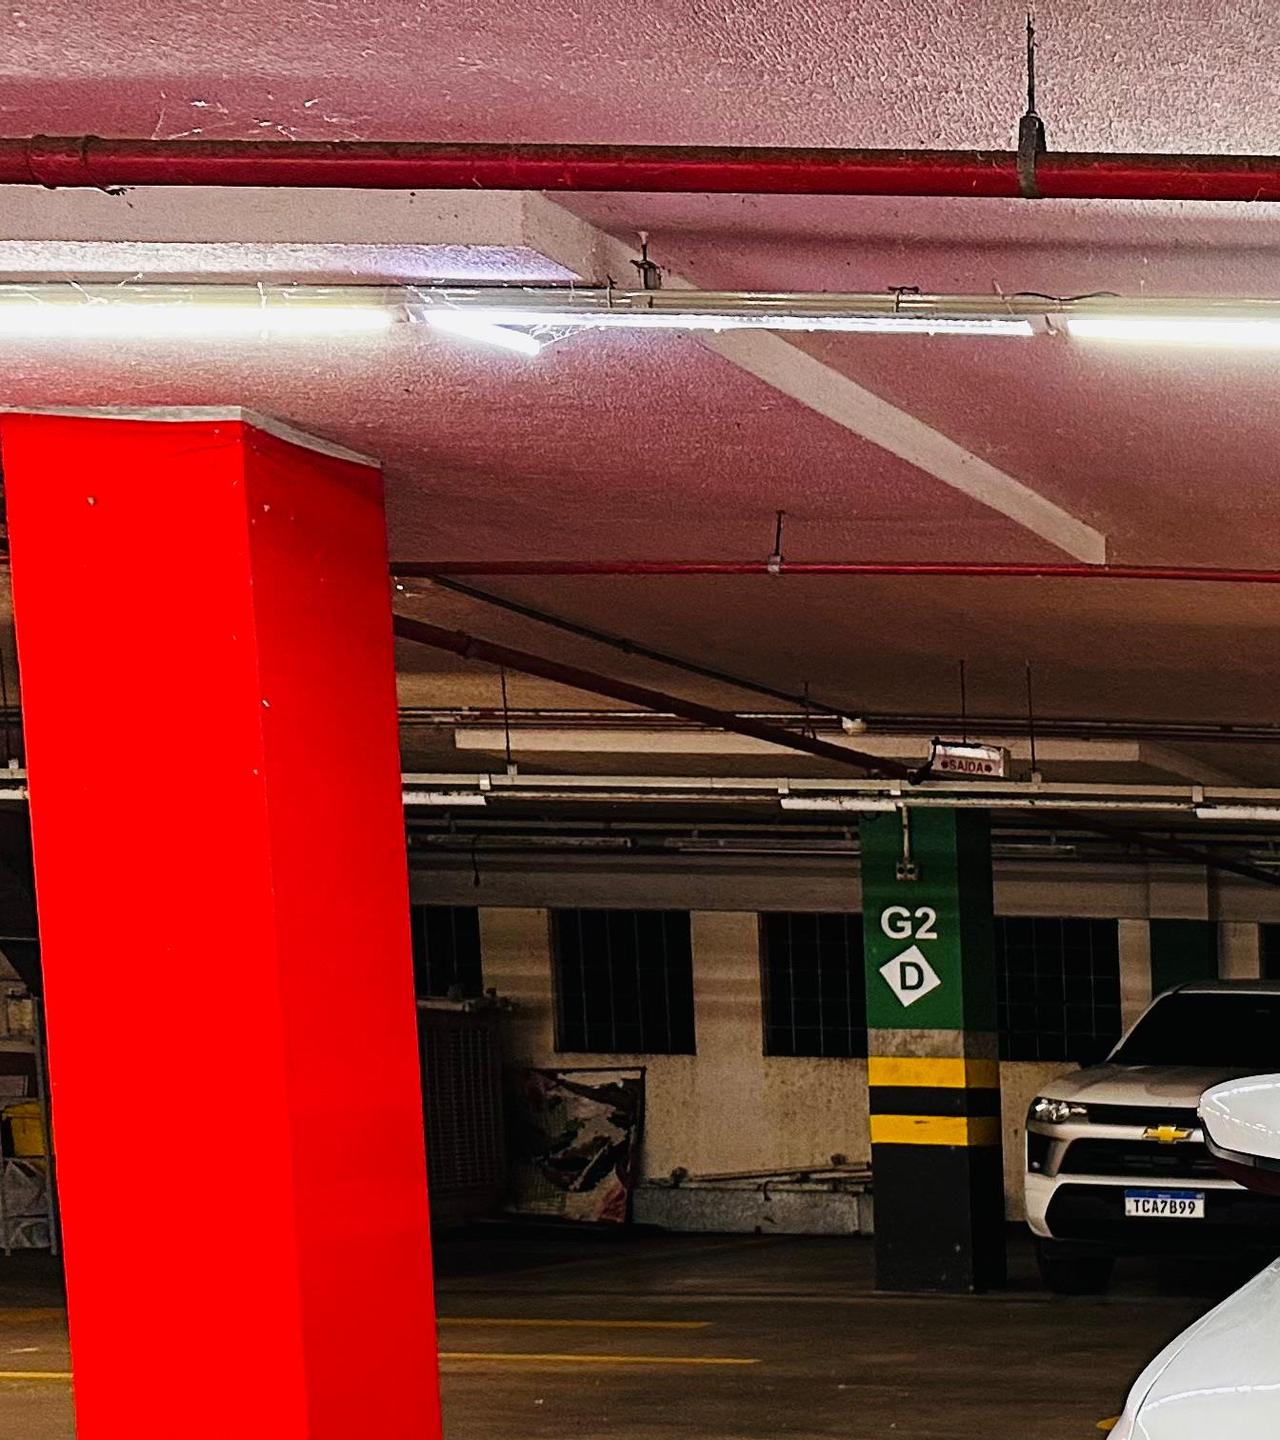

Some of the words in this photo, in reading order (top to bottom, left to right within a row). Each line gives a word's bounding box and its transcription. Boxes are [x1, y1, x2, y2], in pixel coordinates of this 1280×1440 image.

[881, 905, 938, 940] G2
[899, 961, 925, 991] D
[1133, 1199, 1196, 1215] TCA7B99
